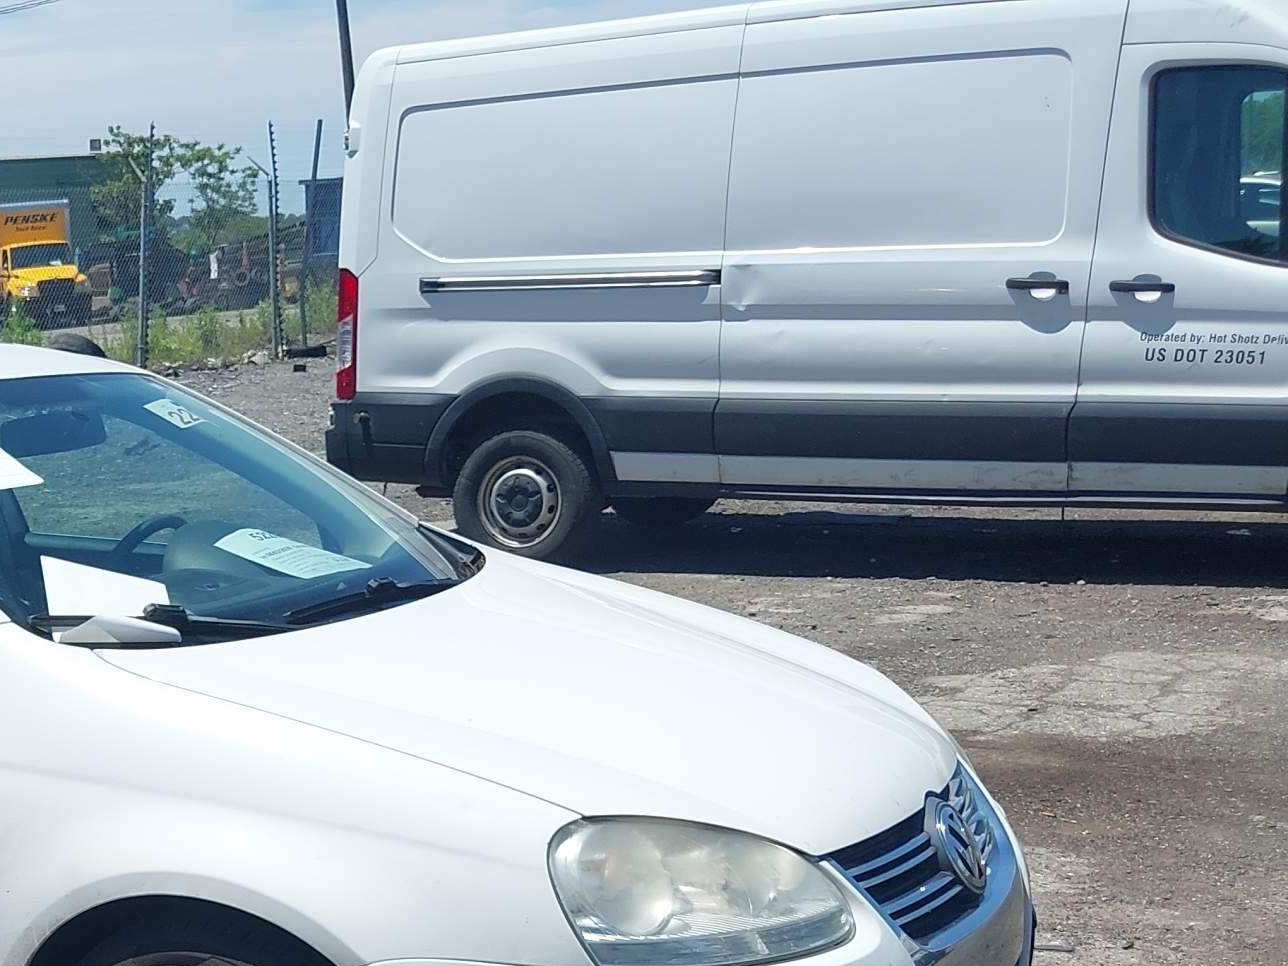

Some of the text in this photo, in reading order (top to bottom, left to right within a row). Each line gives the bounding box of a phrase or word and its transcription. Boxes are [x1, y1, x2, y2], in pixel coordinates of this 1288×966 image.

[3, 213, 57, 225] PENSKE
[1140, 332, 1187, 343] Operated
[1190, 333, 1205, 344] by:
[1209, 333, 1227, 343] Hot
[1230, 334, 1259, 344] Shotz
[1145, 347, 1266, 365] US DOT 23051
